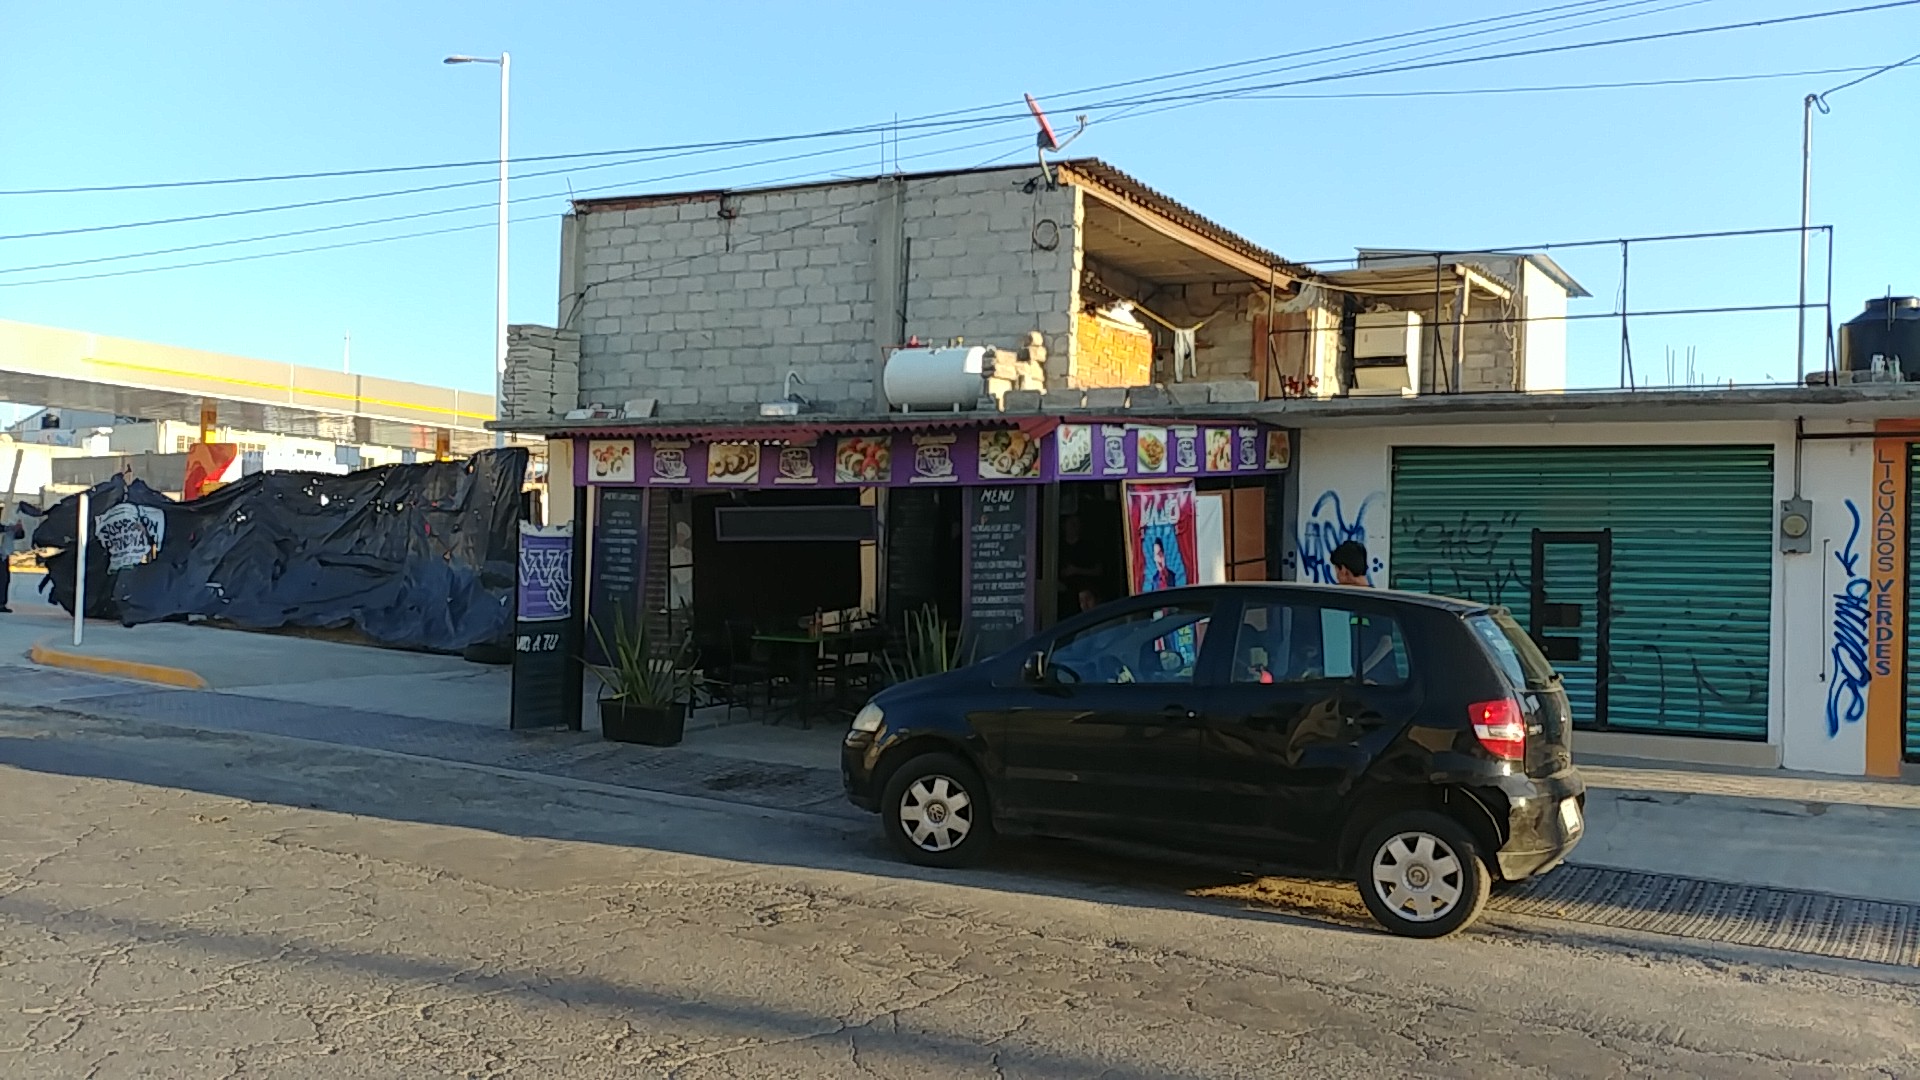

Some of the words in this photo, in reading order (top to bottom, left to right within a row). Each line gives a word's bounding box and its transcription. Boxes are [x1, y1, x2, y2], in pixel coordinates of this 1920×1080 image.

[980, 489, 1015, 504] MENU
[1877, 449, 1896, 572] LICUADOS
[1875, 579, 1894, 676] VERDES
